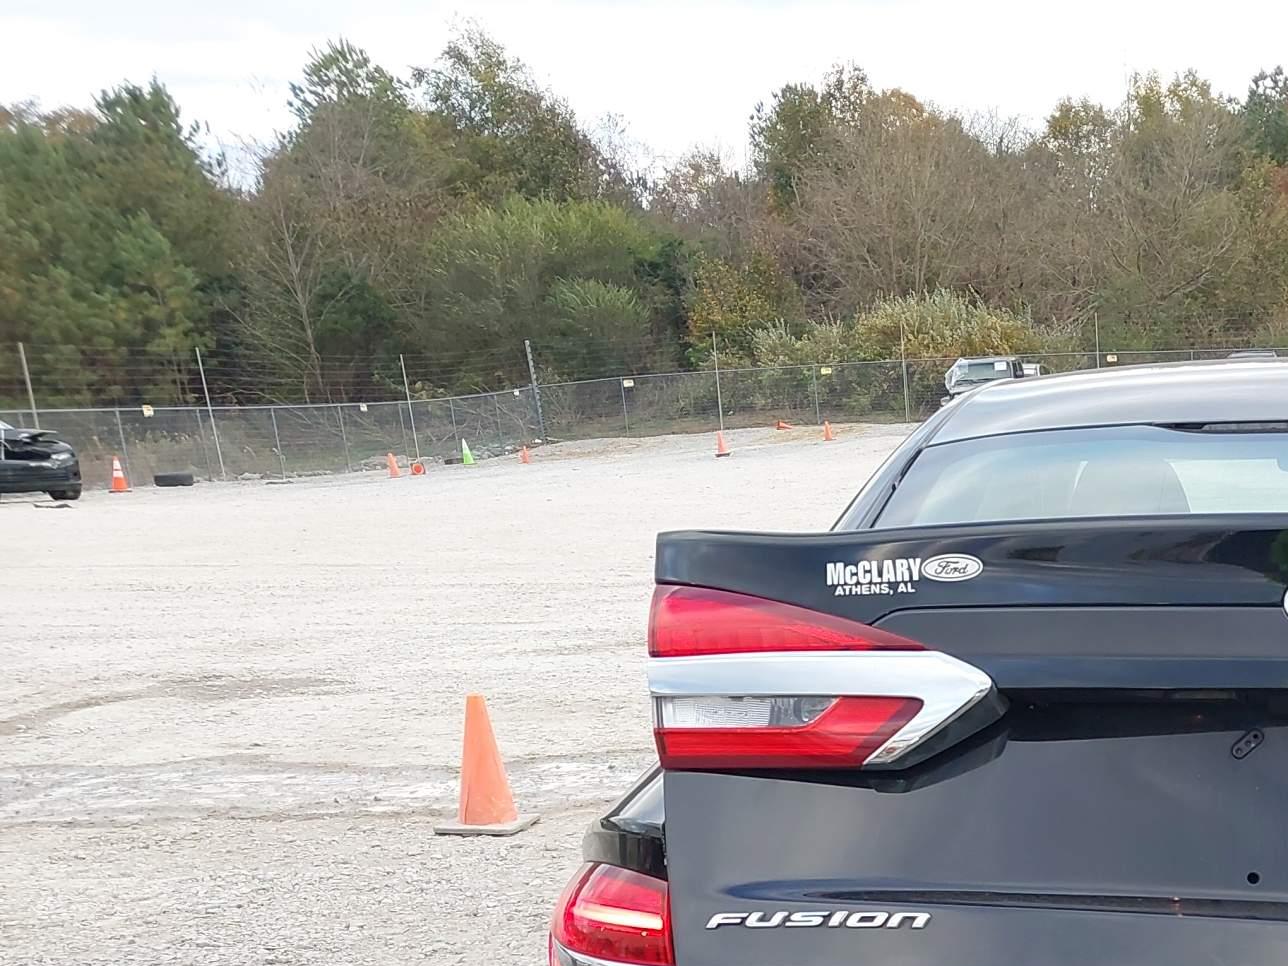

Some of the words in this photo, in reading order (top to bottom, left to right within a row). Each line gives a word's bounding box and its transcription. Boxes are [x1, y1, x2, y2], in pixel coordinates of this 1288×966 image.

[826, 558, 921, 585] McCLARY
[834, 583, 894, 596] ATHENS,
[897, 581, 915, 593] AL
